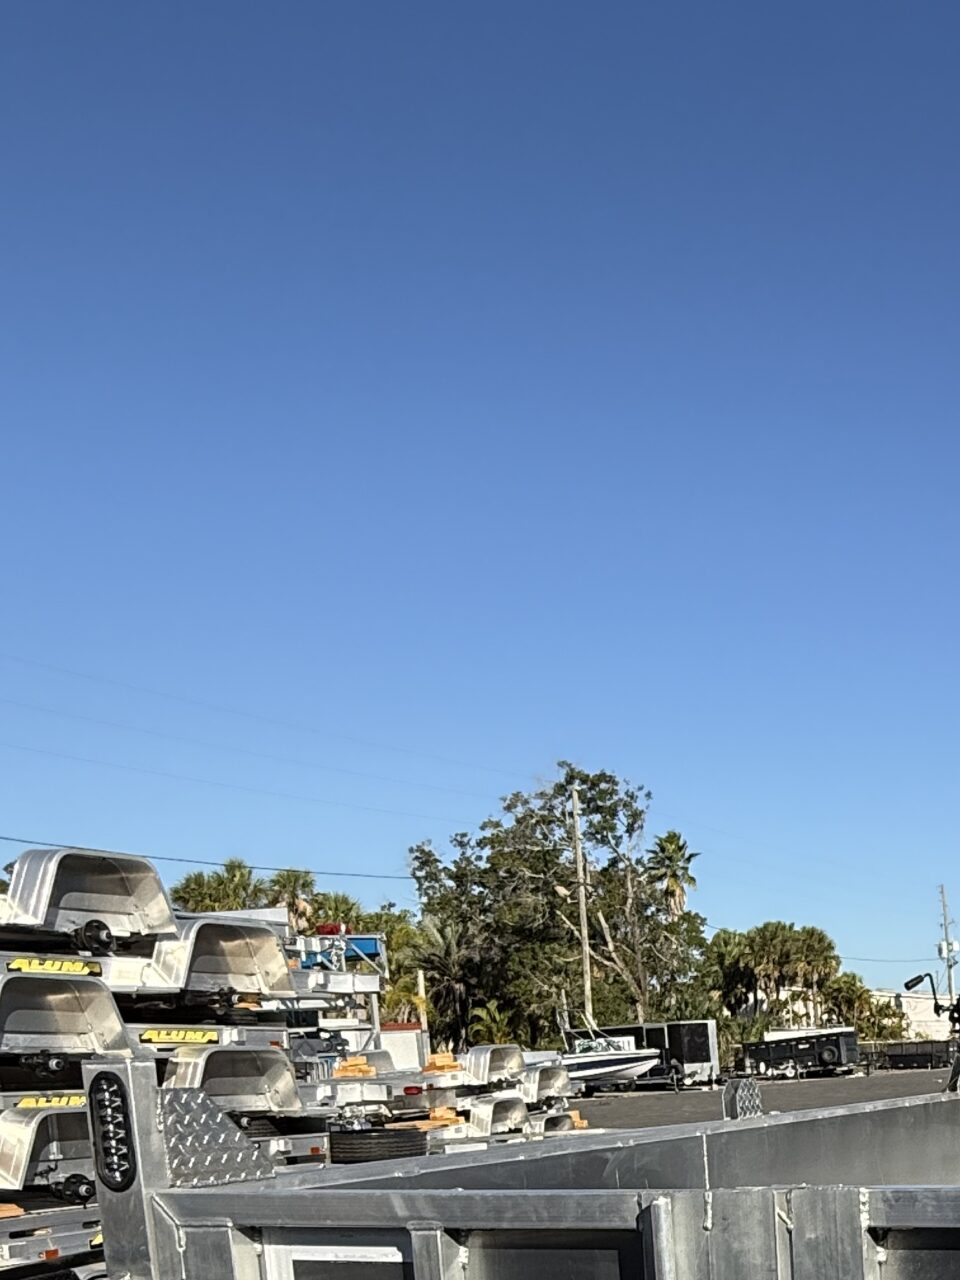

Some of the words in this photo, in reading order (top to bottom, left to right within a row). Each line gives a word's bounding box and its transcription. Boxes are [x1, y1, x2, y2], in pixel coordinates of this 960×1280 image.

[8, 958, 101, 976] ALUMA
[141, 1030, 218, 1043] ALUMA
[16, 1096, 87, 1108] ALUM
